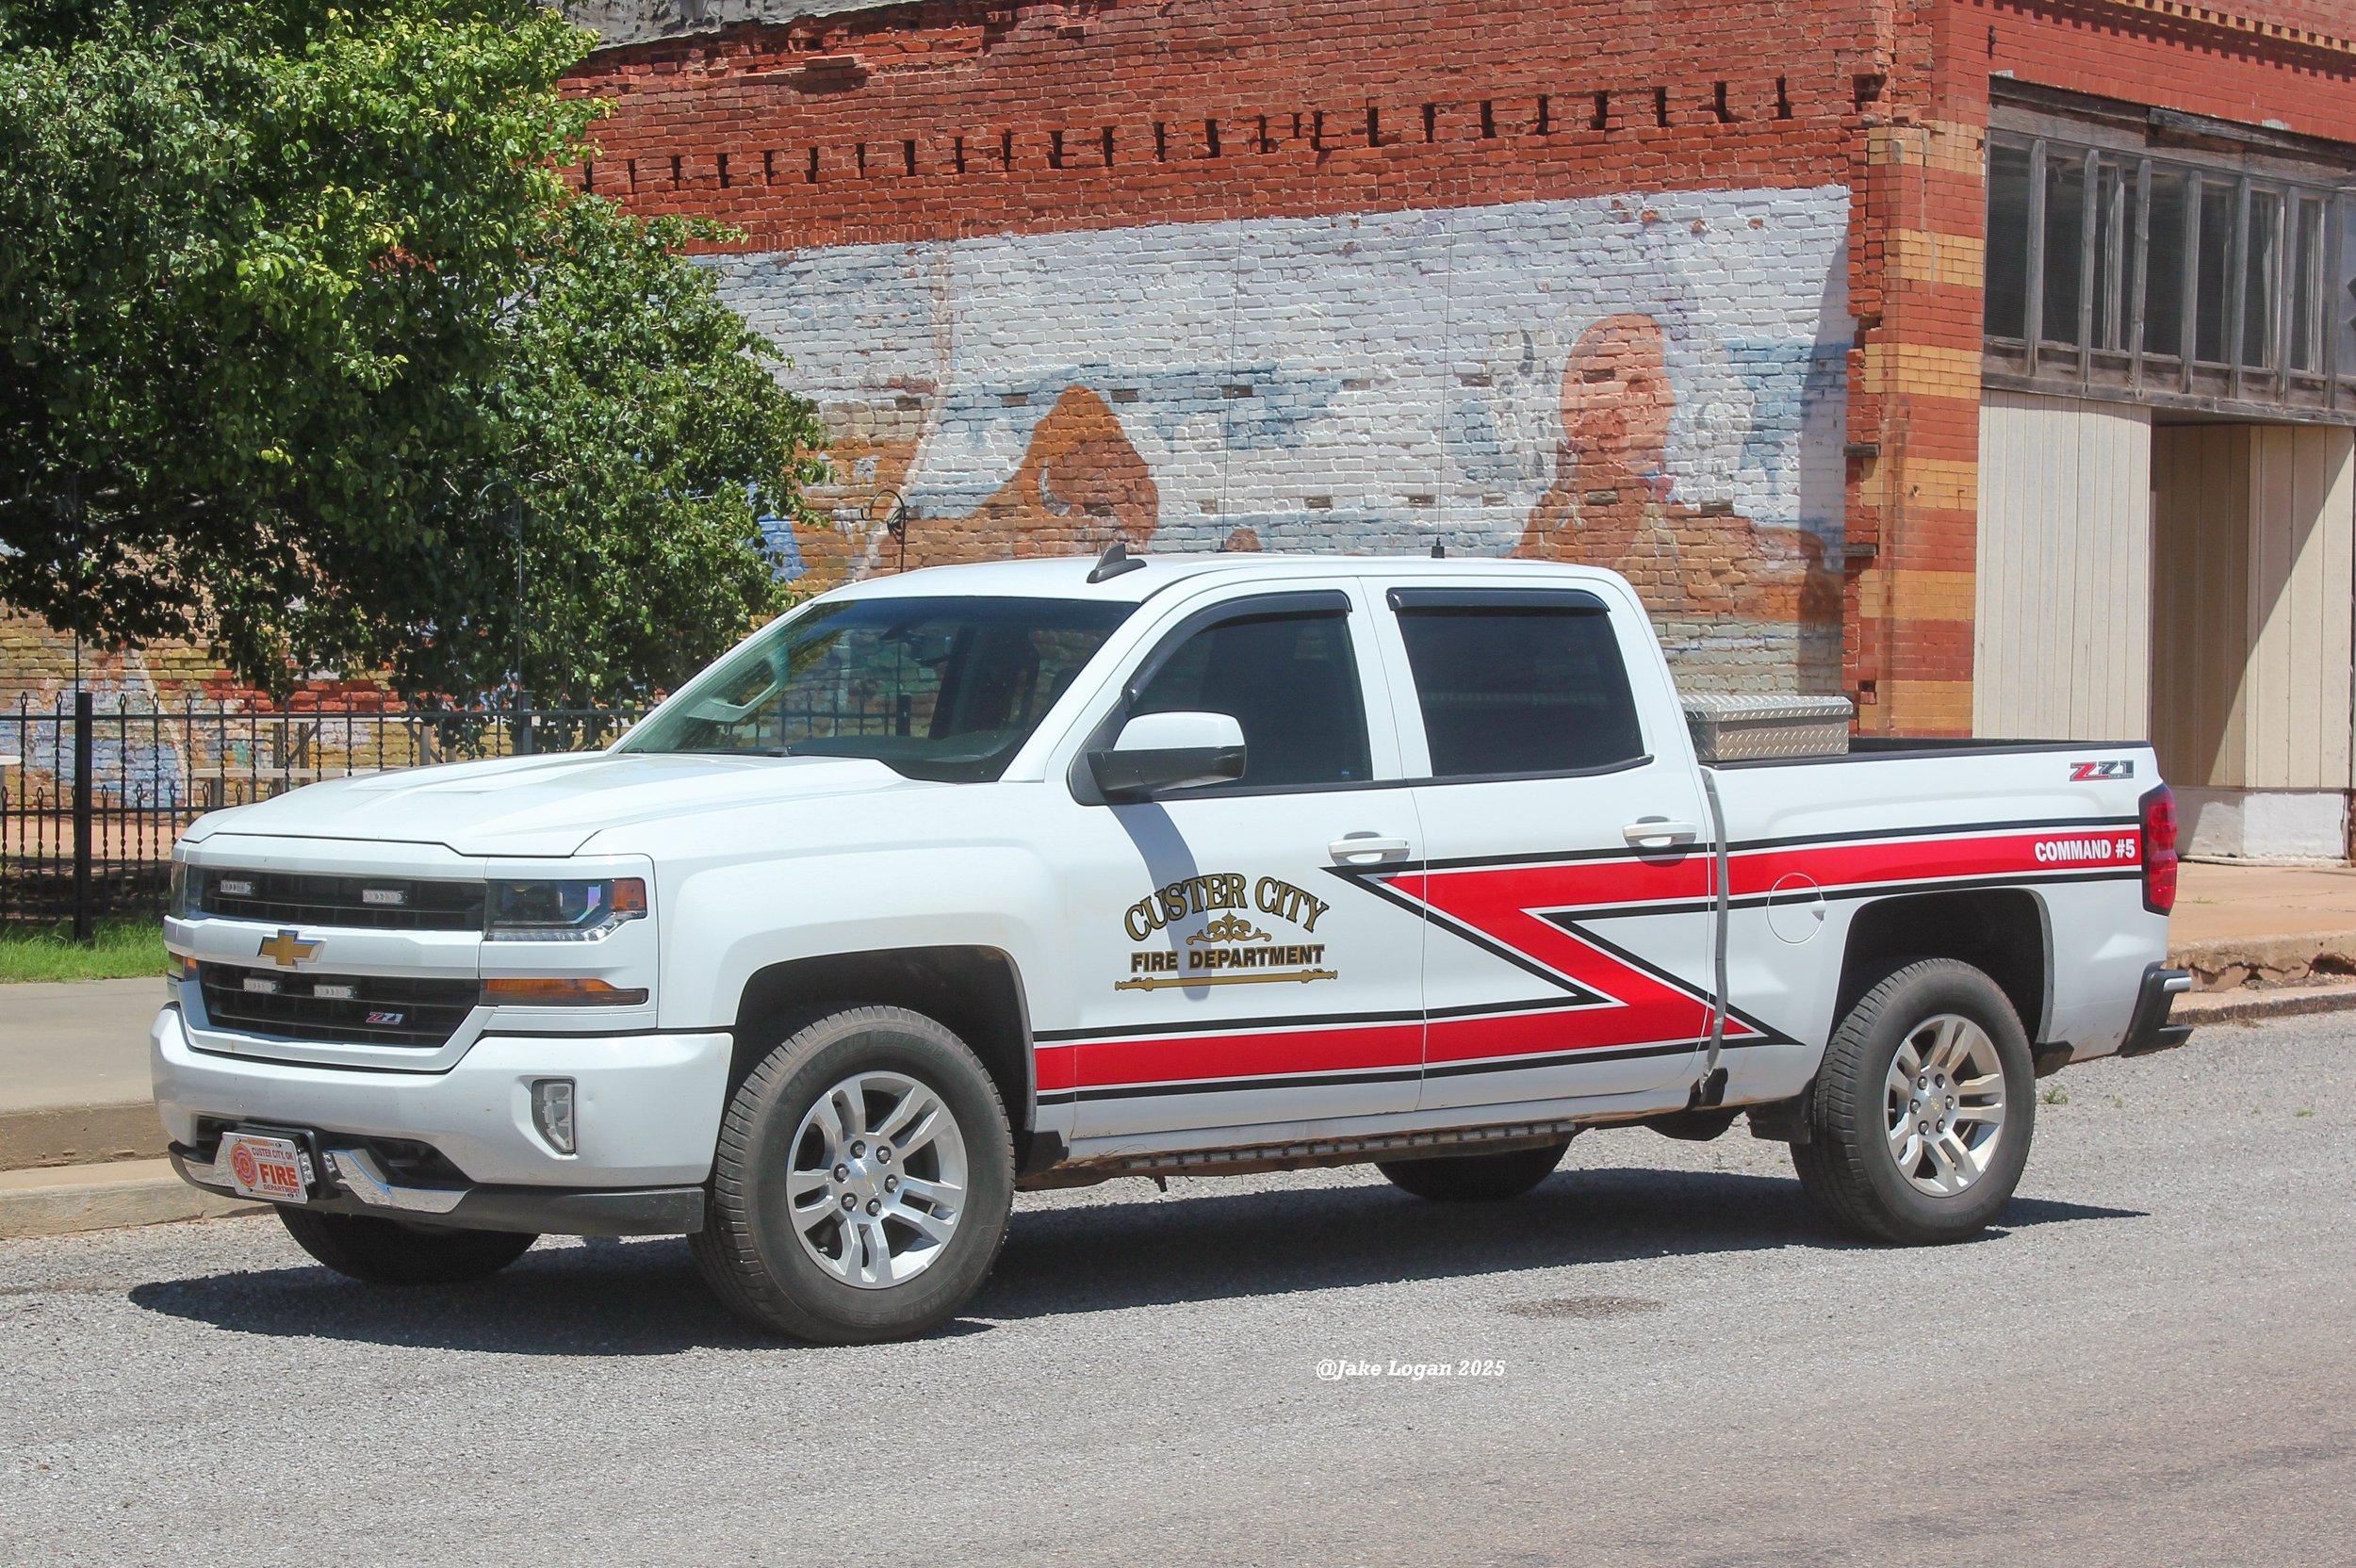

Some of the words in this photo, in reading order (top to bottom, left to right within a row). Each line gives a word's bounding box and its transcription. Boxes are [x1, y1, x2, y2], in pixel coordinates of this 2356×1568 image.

[2070, 760, 2135, 781] Z71
[2035, 839, 2112, 861] COMMAND
[2115, 838, 2135, 859] #5
[1124, 873, 1248, 941] CUSTER
[1254, 875, 1330, 933] CITY
[1130, 950, 1179, 972] FIRE
[1187, 943, 1325, 970] DEPARTMENT
[365, 1011, 404, 1025] Z71
[252, 1147, 271, 1158] CUSTER
[258, 1164, 300, 1187] FIRE
[263, 1184, 301, 1194] DEPARTMENT
